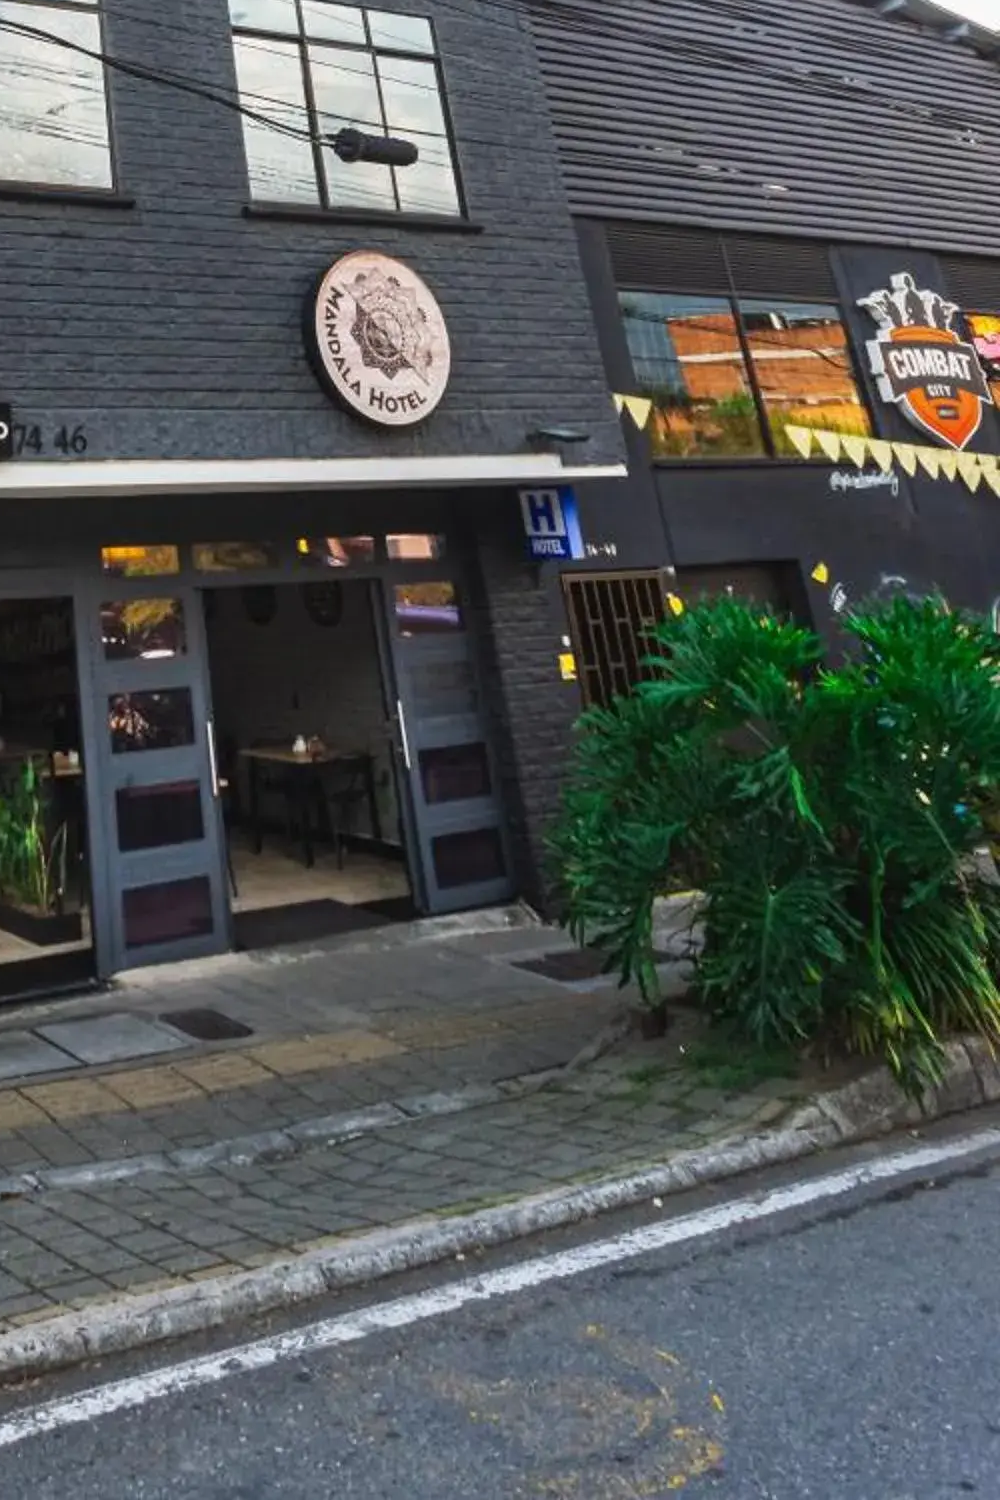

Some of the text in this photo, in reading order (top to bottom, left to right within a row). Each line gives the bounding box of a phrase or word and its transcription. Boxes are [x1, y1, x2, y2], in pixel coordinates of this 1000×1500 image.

[325, 286, 427, 413] MANDALA HOTEL
[888, 348, 971, 380] COMBAT
[926, 383, 951, 397] CITY
[13, 424, 88, 454] 74 46
[532, 538, 566, 555] HOTEL
